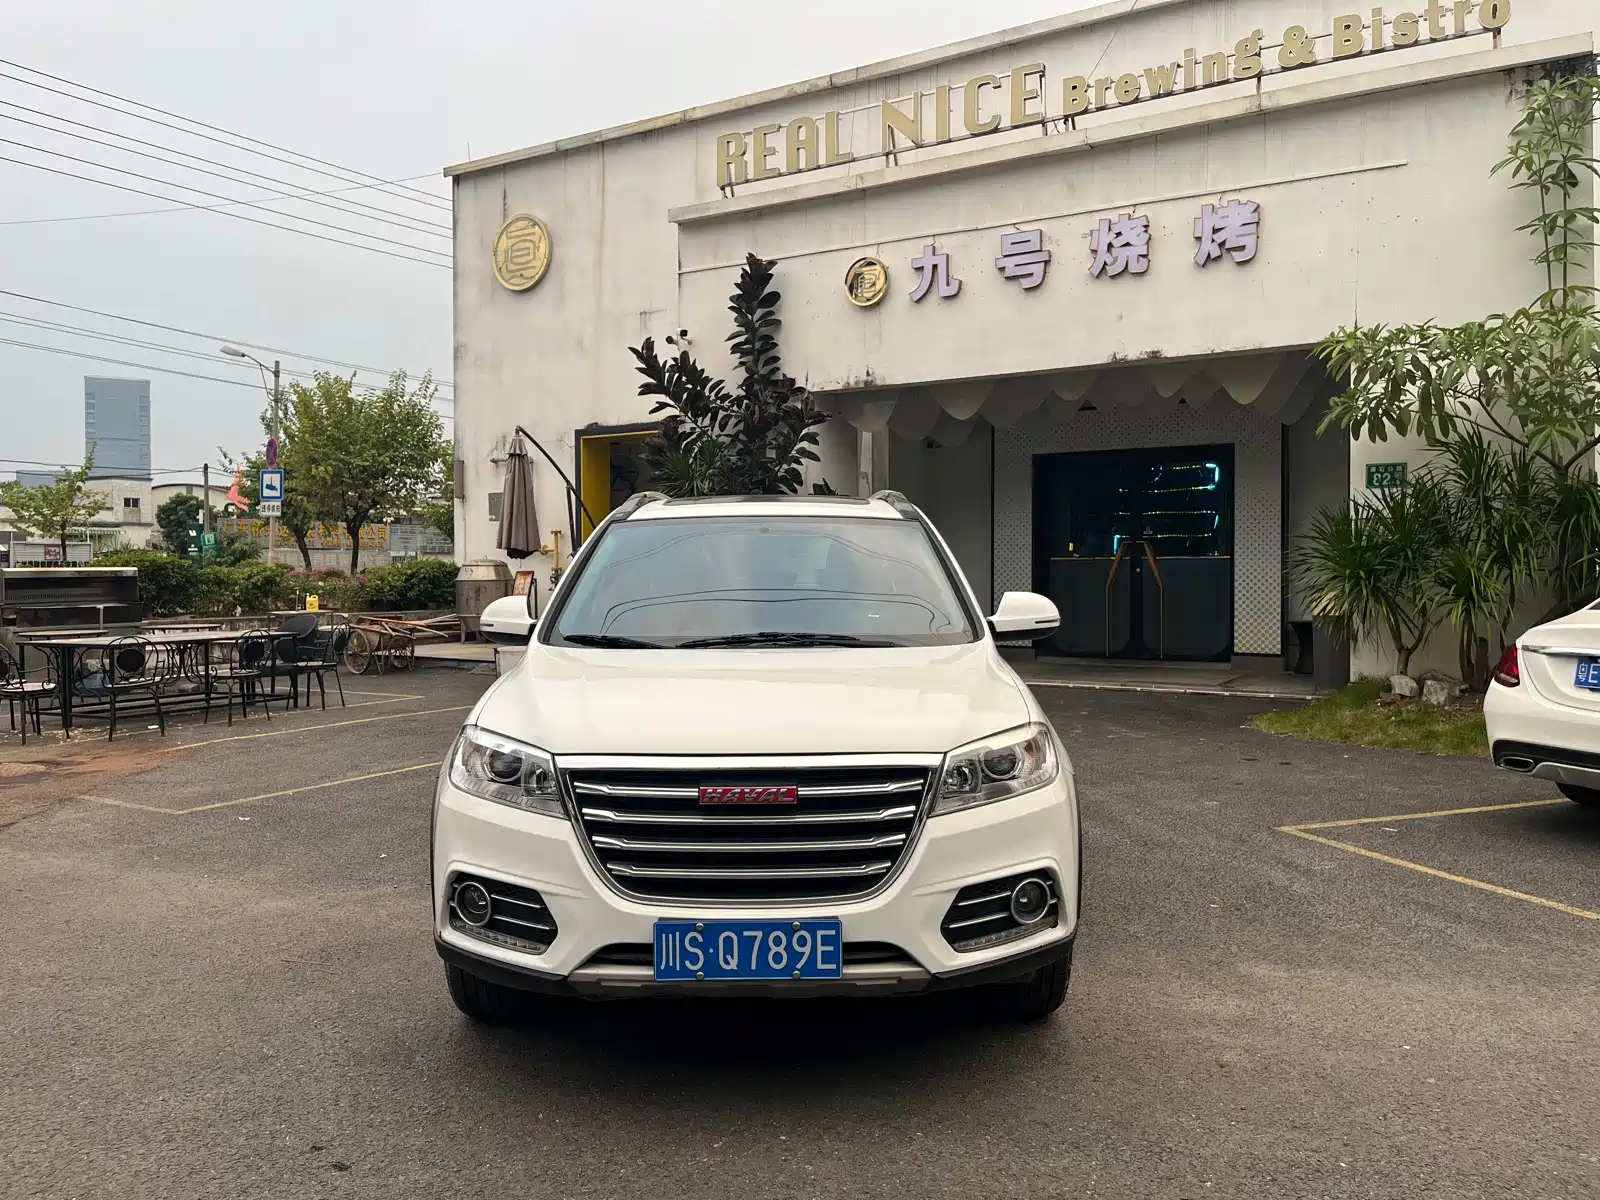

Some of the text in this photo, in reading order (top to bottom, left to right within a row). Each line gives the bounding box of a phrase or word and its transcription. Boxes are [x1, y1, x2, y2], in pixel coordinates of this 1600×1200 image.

[717, 0, 1512, 188] REAL NICE Brewing & Bistro
[908, 199, 1261, 303] 九号烧烤
[703, 788, 794, 802] HAVAL
[660, 930, 837, 971] 川S·Q789E
